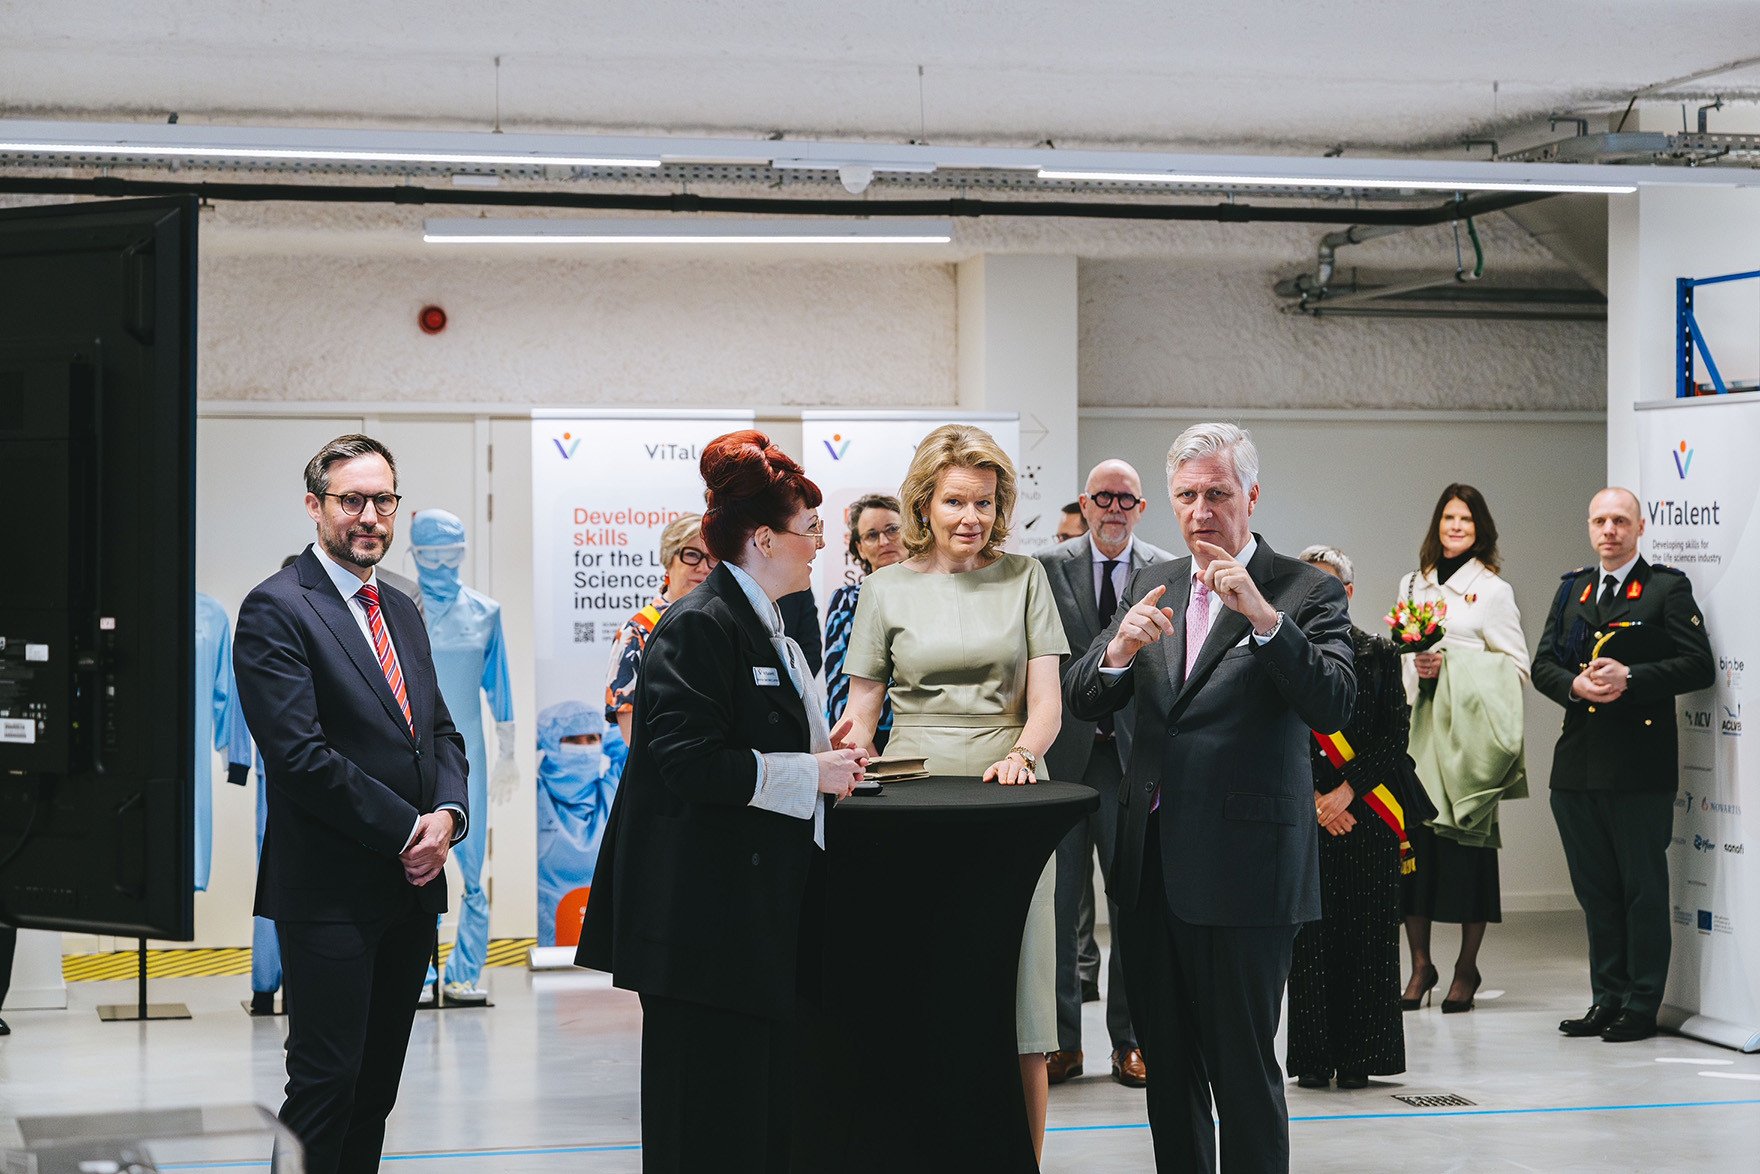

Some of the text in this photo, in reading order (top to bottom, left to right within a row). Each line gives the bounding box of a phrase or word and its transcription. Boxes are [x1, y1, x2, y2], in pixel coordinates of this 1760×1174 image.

[645, 444, 702, 460] ViTal
[573, 508, 695, 528] Developin
[1648, 500, 1720, 525] ViTalent
[573, 528, 629, 546] skills
[1652, 539, 1709, 551] Developing skills for
[574, 550, 603, 567] for
[610, 550, 643, 567] the
[1652, 553, 1722, 565] the life sciences industry
[574, 592, 654, 609] industr
[1694, 711, 1711, 728] ACV
